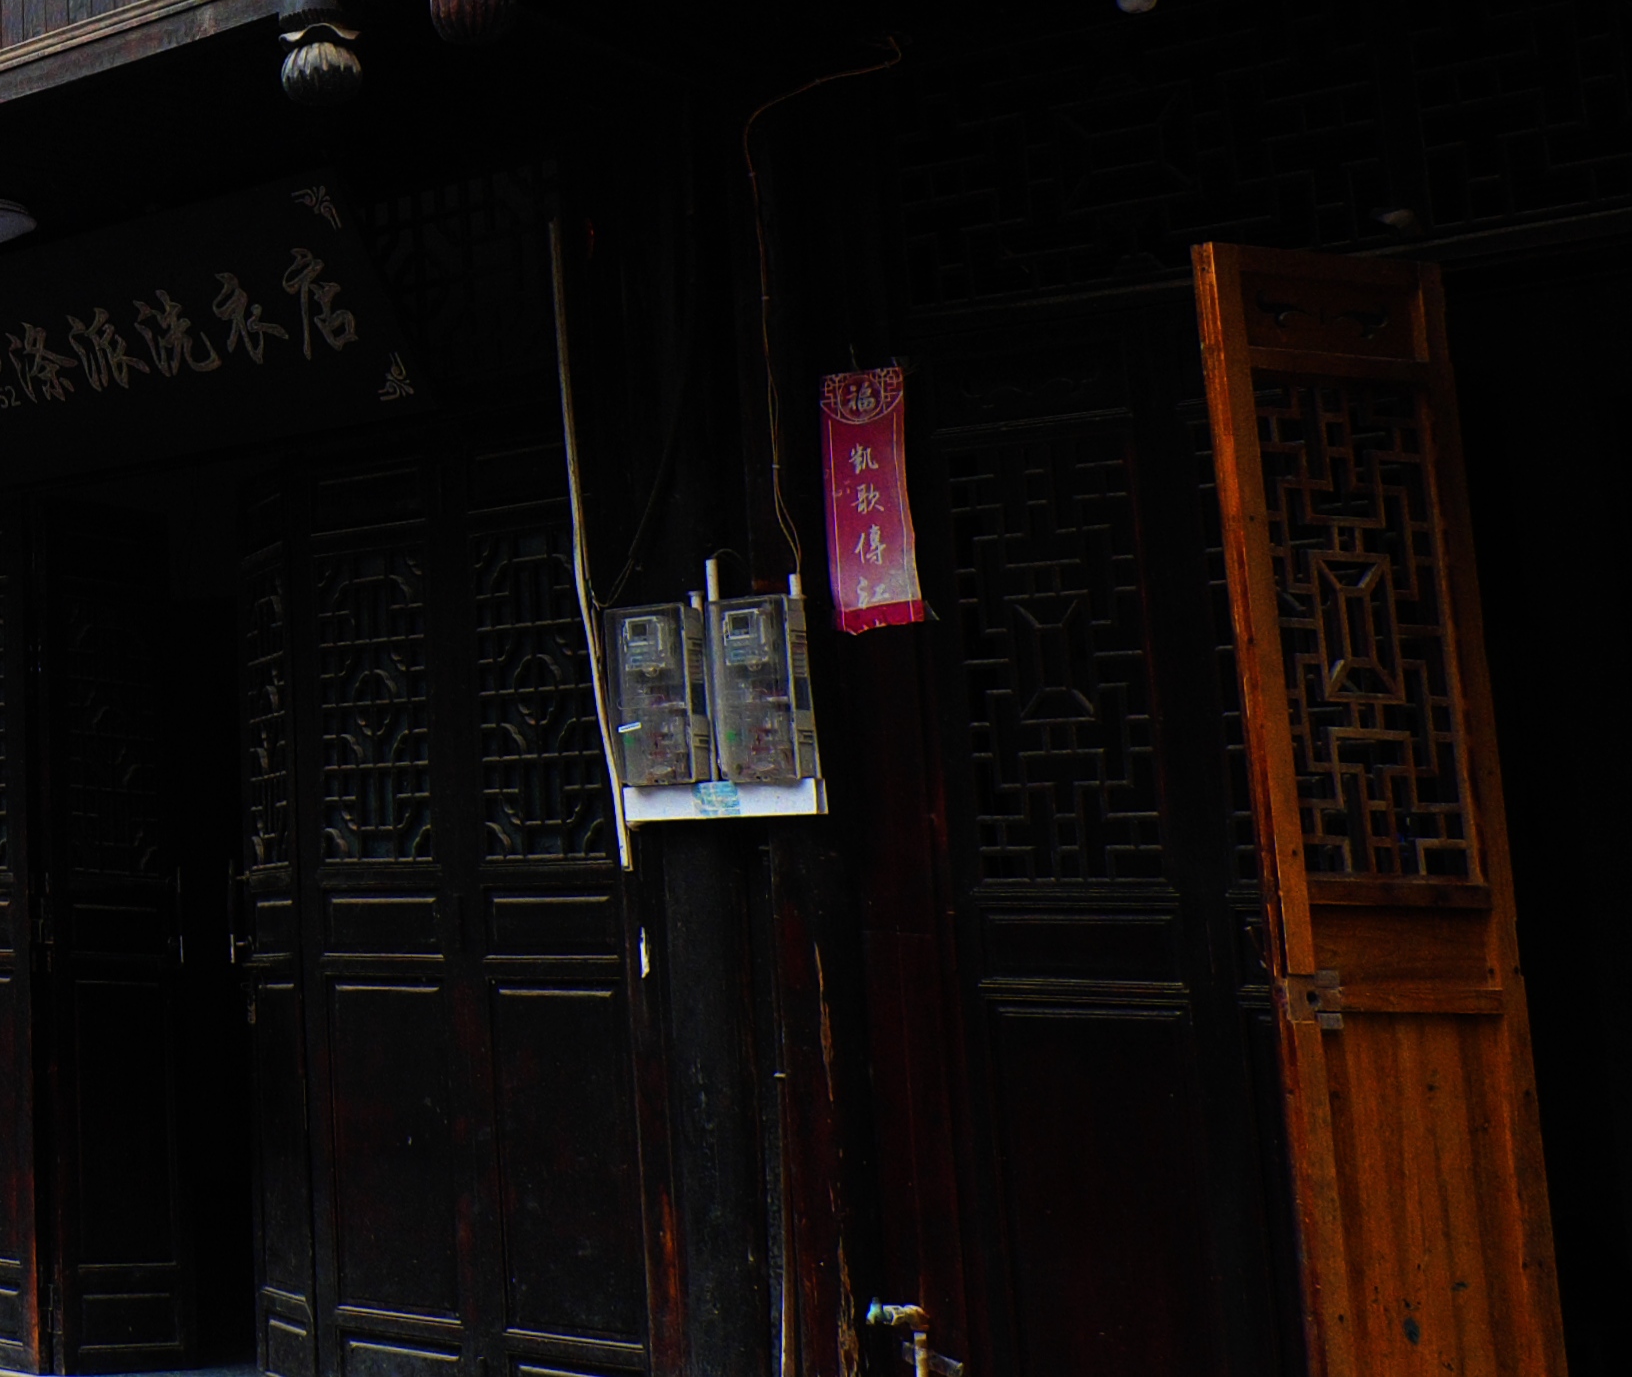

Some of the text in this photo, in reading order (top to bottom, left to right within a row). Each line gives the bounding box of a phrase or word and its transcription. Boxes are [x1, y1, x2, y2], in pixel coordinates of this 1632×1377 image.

[5, 247, 359, 405] 涤派洗衣店
[846, 380, 877, 412] 福
